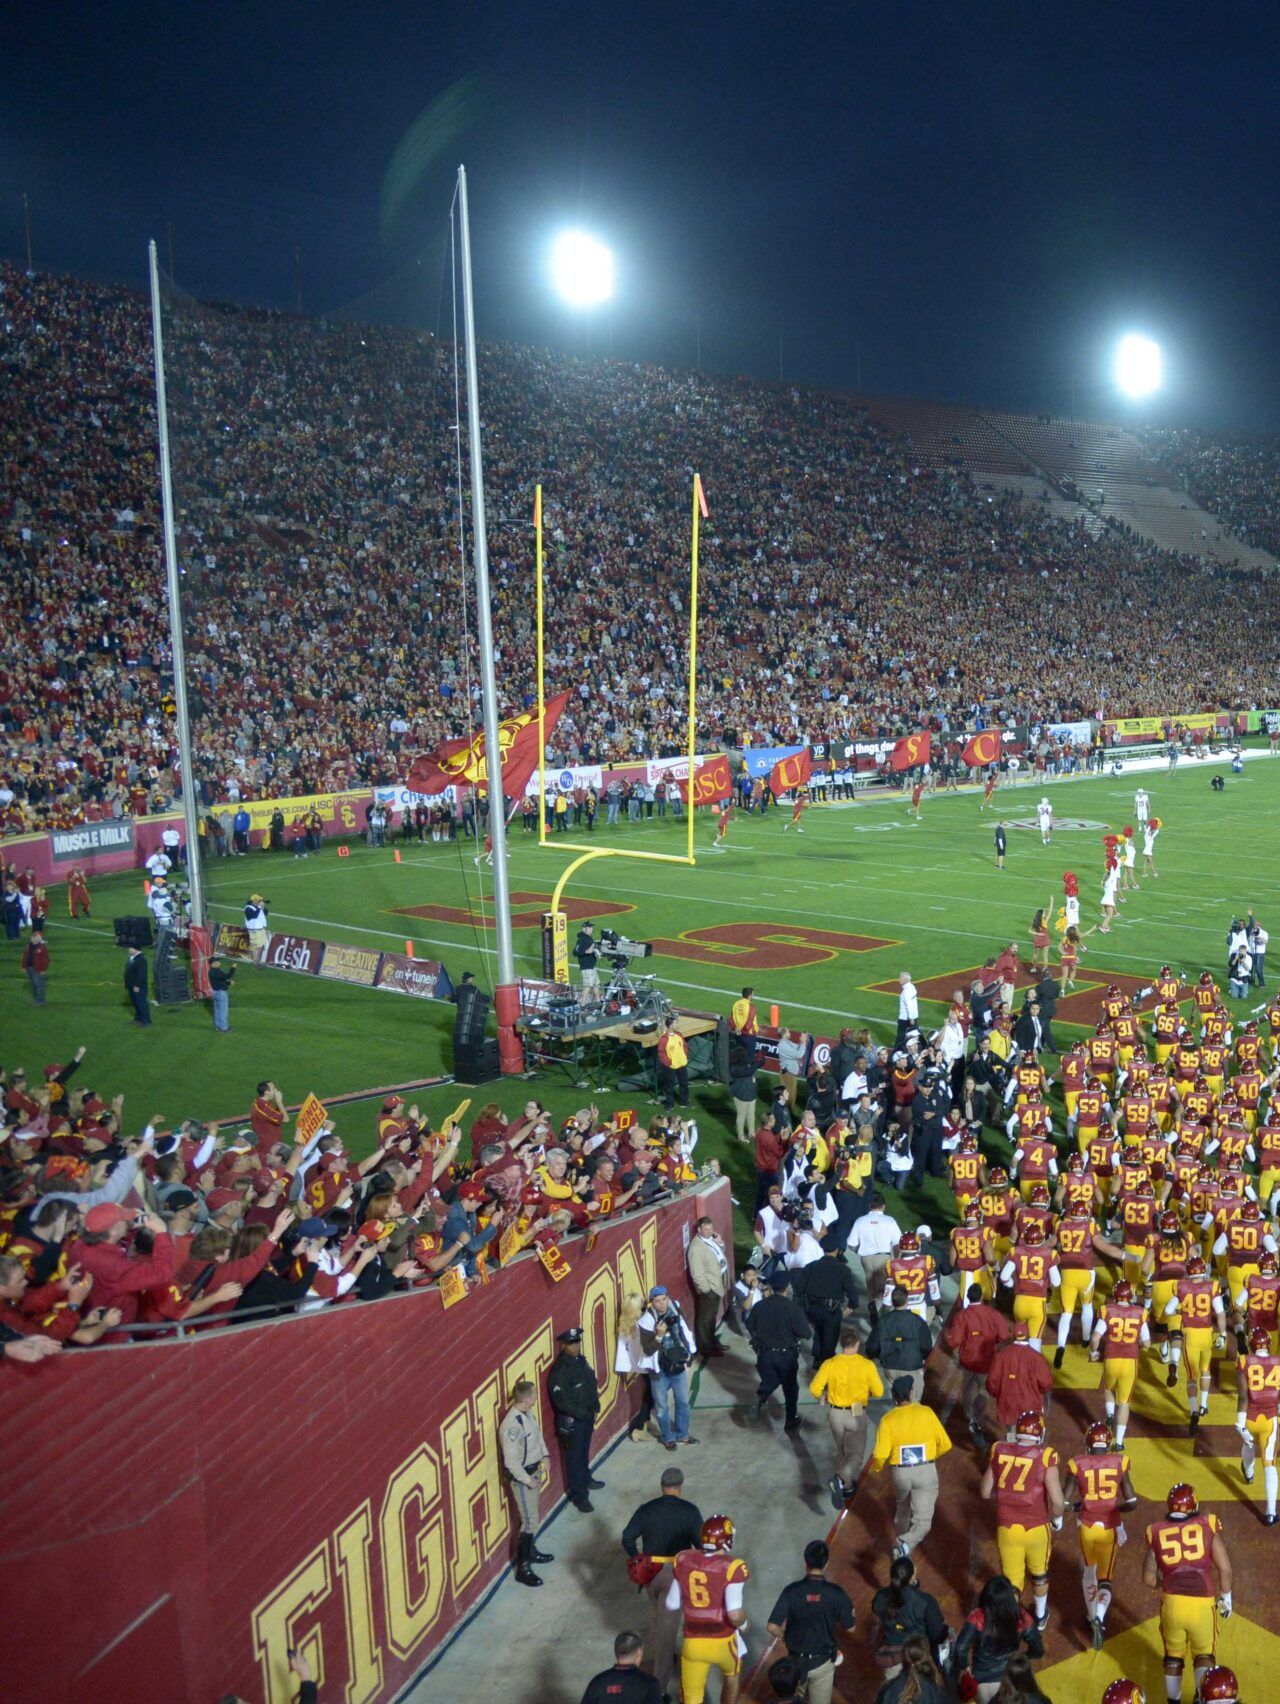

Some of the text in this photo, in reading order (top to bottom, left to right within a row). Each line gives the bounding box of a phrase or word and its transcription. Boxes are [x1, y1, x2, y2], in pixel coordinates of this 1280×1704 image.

[813, 745, 825, 757] yp
[907, 736, 922, 763] S
[973, 734, 995, 762] C
[574, 773, 599, 785] Dental
[778, 758, 801, 788] U
[685, 766, 727, 801] USC
[54, 827, 131, 854] MUSCLE MILK
[274, 937, 311, 971] dish
[338, 950, 379, 971] CREATIVE
[394, 968, 405, 980] on
[1160, 983, 1177, 998] 40
[1198, 991, 1212, 1006] 10
[1116, 1020, 1134, 1037] 31
[1157, 1015, 1175, 1033] 66
[1092, 1041, 1112, 1058] 65
[1180, 1051, 1199, 1068] 95
[1237, 1043, 1257, 1060] 42
[1019, 1069, 1040, 1085] 56
[1067, 1061, 1077, 1078] 4
[1147, 1082, 1168, 1101] 57
[1238, 1083, 1259, 1100] 40
[1079, 1099, 1100, 1114] 53
[1127, 1104, 1149, 1123] 59
[1022, 1110, 1041, 1128] 41
[1181, 1130, 1204, 1151] 54
[1220, 1136, 1246, 1156] 44
[1029, 1147, 1044, 1167] 4
[1090, 1145, 1108, 1165] 51
[1143, 1146, 1166, 1165] 34
[953, 1159, 977, 1179] 80
[1069, 1184, 1094, 1201] 29
[981, 1195, 1007, 1217] 98
[1124, 1203, 1150, 1225] 63
[955, 1236, 981, 1259] 88
[1059, 1230, 1086, 1253] 87
[1231, 1226, 1257, 1250] 50
[1019, 1255, 1044, 1280] 13
[895, 1269, 925, 1291] 52
[1181, 1293, 1211, 1319] 49
[1249, 1287, 1277, 1311] 28
[1108, 1317, 1140, 1344] 35
[251, 1214, 658, 1704] FIGHT ON
[997, 1453, 1034, 1492] 77
[1084, 1468, 1118, 1501] 15
[1158, 1523, 1205, 1565] 59
[688, 1569, 711, 1608] 6
